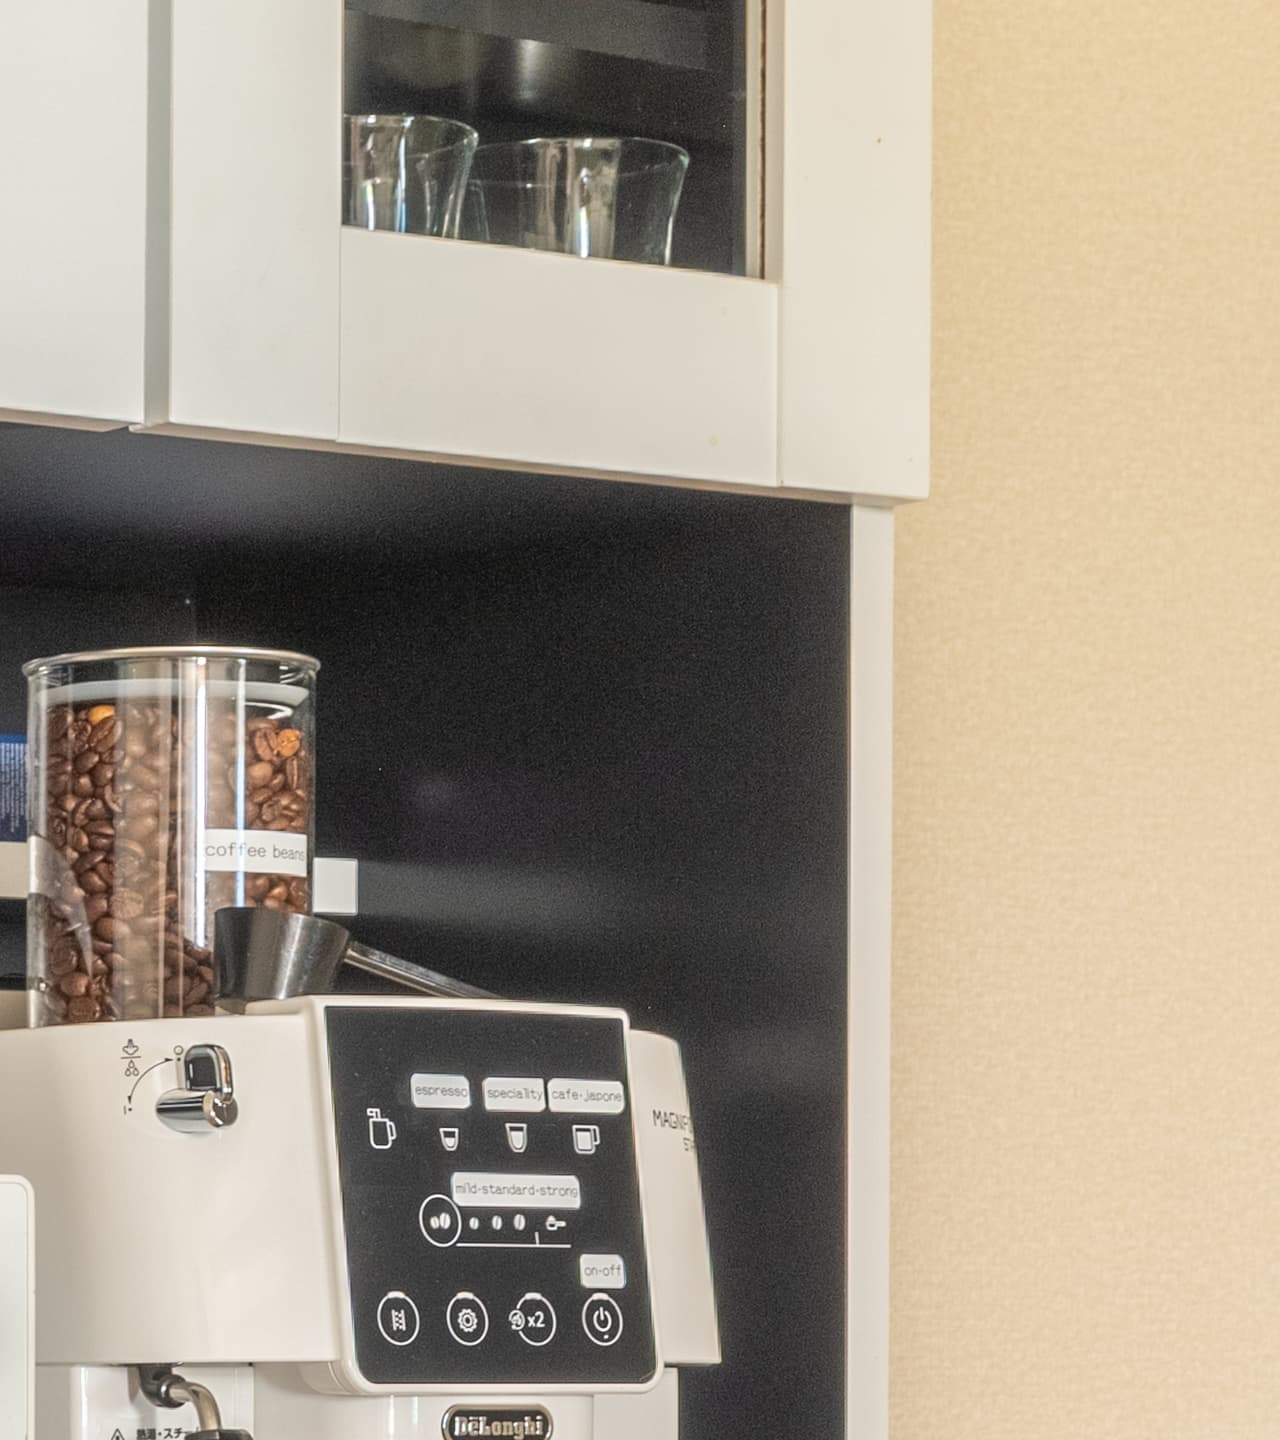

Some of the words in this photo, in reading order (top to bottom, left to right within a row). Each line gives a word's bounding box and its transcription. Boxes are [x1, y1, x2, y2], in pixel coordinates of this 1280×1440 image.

[204, 841, 267, 858] coffee
[272, 843, 306, 862] beans
[413, 1084, 470, 1099] espresso
[486, 1087, 544, 1102] speciality
